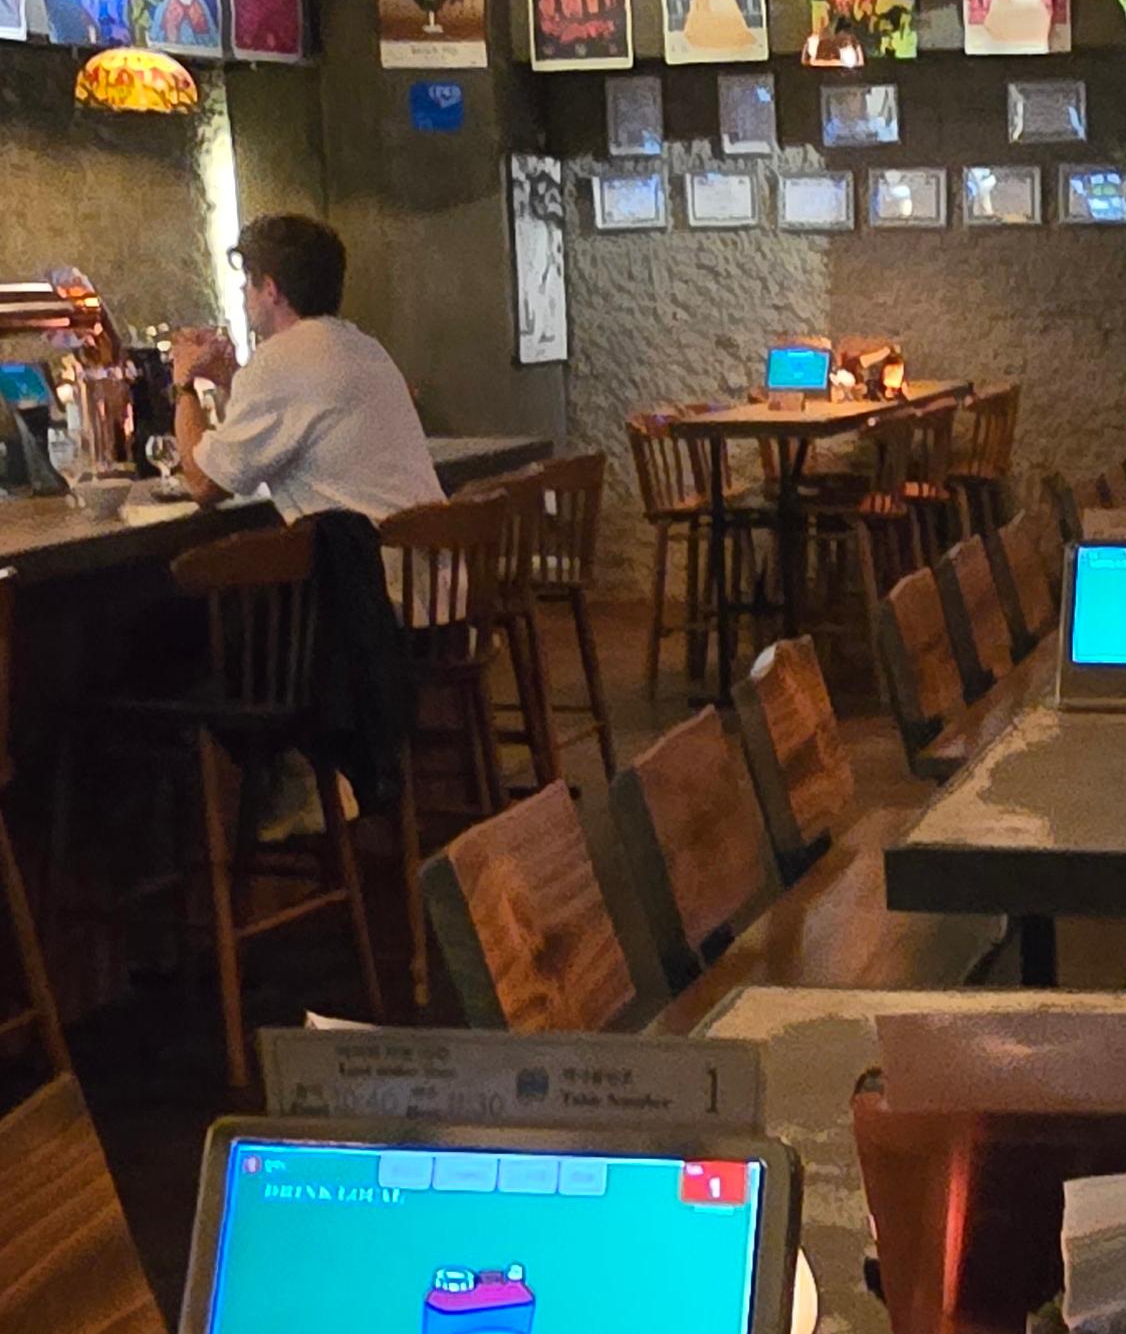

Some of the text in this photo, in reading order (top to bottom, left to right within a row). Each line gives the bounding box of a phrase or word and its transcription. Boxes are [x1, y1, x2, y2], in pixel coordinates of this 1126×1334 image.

[706, 1067, 718, 1113] 1
[264, 1183, 405, 1205] DRINK LOCAL
